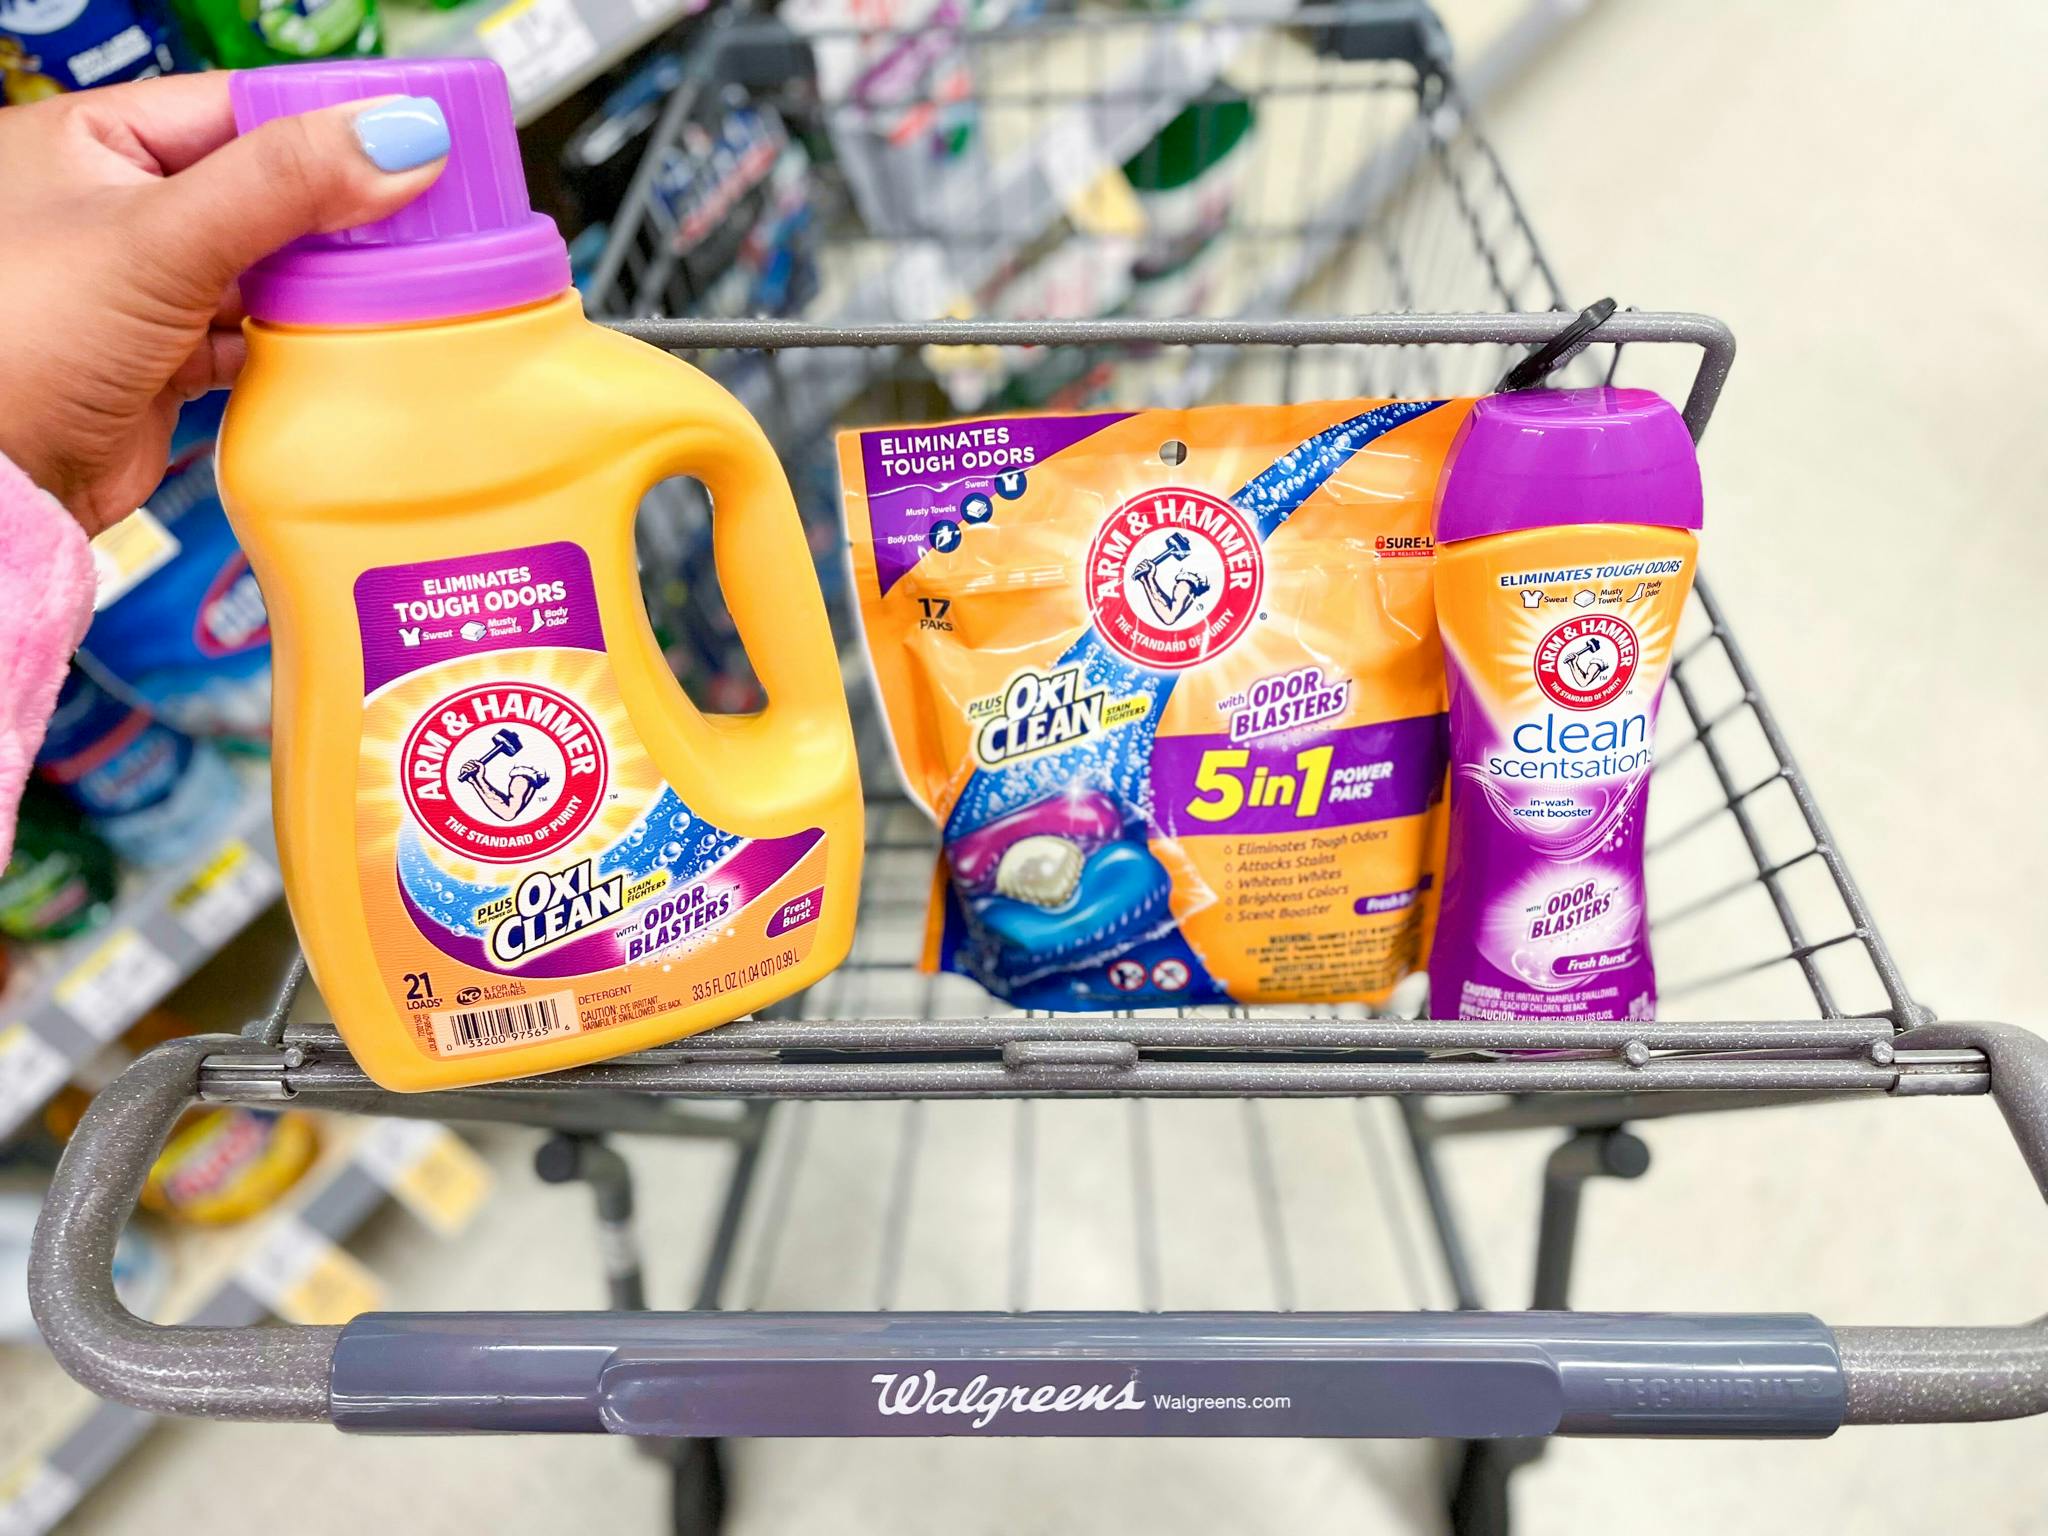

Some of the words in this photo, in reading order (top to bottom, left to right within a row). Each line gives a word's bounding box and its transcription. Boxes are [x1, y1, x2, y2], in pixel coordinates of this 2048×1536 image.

[880, 427, 1010, 456] ELIMINATES
[881, 454, 955, 477] TOUGH
[962, 446, 1036, 469] ODORS
[965, 480, 989, 490] Sweat
[906, 507, 929, 517] Musty
[931, 504, 956, 515] Towels
[887, 535, 908, 545] Body
[908, 533, 926, 544] Odor
[1097, 531, 1132, 600] ARM
[1126, 511, 1153, 536] &
[1154, 498, 1253, 591] HAMMER
[1386, 537, 1435, 549] SURE-L
[423, 566, 531, 596] ELIMINATES
[1500, 568, 1593, 587] ELIMINATES
[1595, 563, 1644, 579] TOUGH
[1644, 560, 1683, 574] ODORS
[1601, 588, 1624, 598] Musty
[1644, 589, 1661, 598] Odor
[1646, 580, 1662, 590] Body
[393, 594, 480, 623] TOUGH
[484, 581, 567, 612] ODORS
[918, 598, 951, 619] 17
[1543, 594, 1568, 604] Sweat
[1598, 594, 1623, 604] Towels
[488, 616, 518, 629] Musty
[544, 607, 568, 619] Body
[546, 616, 568, 628] Odor
[423, 629, 453, 641] Sweat
[490, 625, 522, 637] Towels
[920, 619, 953, 631] PAKS
[1115, 614, 1132, 635] THE
[1130, 628, 1188, 653] STANDARD
[1188, 637, 1203, 650] OF
[1540, 635, 1564, 673] ARM
[1562, 626, 1580, 641] &
[1581, 619, 1633, 668] HAMMER
[1004, 668, 1079, 720] OXI
[1252, 671, 1319, 708] ODOR
[1551, 681, 1561, 693] THE
[1560, 690, 1593, 703] STANDARD
[1593, 692, 1603, 701] OF
[1602, 677, 1622, 696] PURITY
[967, 695, 1002, 715] PLUS
[1106, 702, 1131, 716] STAIN
[1218, 693, 1245, 711] with
[1234, 687, 1345, 738] BLASTERS
[1105, 706, 1146, 725] FIGHTERS
[978, 691, 1104, 765] CLEAN
[1513, 713, 1647, 754] clean
[414, 730, 453, 800] ARM
[441, 711, 475, 737] &
[471, 693, 597, 777] HAMMER
[1331, 761, 1394, 787] POWER
[1328, 781, 1374, 803] PAKS
[1530, 798, 1574, 807] in-wash
[444, 816, 467, 837] THE
[467, 830, 534, 849] STANDARD
[535, 827, 551, 841] OF
[549, 795, 583, 833] PURITY
[1513, 808, 1545, 818] scent
[1547, 807, 1593, 818] booster
[1237, 839, 1306, 856] Eliminates
[1311, 832, 1348, 849] Tough
[1351, 829, 1389, 843] Odors
[1238, 858, 1291, 873] Attacks
[1296, 854, 1336, 867] Stains
[514, 859, 591, 918] OXI
[627, 879, 652, 896] STAIN
[1239, 874, 1294, 889] Whitens
[1298, 868, 1342, 884] Whites
[627, 879, 667, 904] FIGHTERS
[1239, 889, 1305, 906] Brightens
[1307, 884, 1348, 900] Colors
[1547, 882, 1596, 916] ODOR
[477, 897, 513, 920] PLUS
[643, 884, 706, 929] ODOR
[783, 897, 812, 918] Fresh
[1237, 908, 1275, 922] Scent
[1279, 903, 1331, 919] Booster
[1530, 892, 1611, 939] BLASTERS
[492, 875, 624, 962] CLEAN
[628, 892, 731, 963] BLASTERS
[615, 924, 638, 939] WITH
[1567, 957, 1596, 971] Fresh
[1598, 952, 1628, 967] Burst
[692, 984, 713, 1002] 33.5
[713, 980, 724, 994] FL
[725, 974, 738, 990] OZ
[739, 966, 759, 988] (1.04
[760, 957, 775, 980] QT)
[776, 951, 793, 973] 0.99
[794, 947, 800, 964] L
[403, 972, 434, 1000] 21
[484, 988, 527, 1001] MACHINES
[491, 984, 508, 993] FOR
[509, 981, 524, 990] ALL
[578, 984, 633, 1006] DETERGENT
[1503, 991, 1515, 1000] EYE
[1546, 992, 1575, 1001] HARMFUL
[1576, 992, 1582, 1000] IF
[580, 1005, 619, 1023] CAUTION:
[619, 1002, 632, 1013] EYE
[1500, 1001, 1521, 1010] REACH
[1521, 1002, 1530, 1010] OF
[582, 1017, 611, 1032] HARMFUL
[612, 1015, 618, 1025] IF
[657, 1002, 668, 1013] SEE
[871, 1368, 1146, 1429] Walgreens
[1153, 1393, 1291, 1413] Walgreens.com
